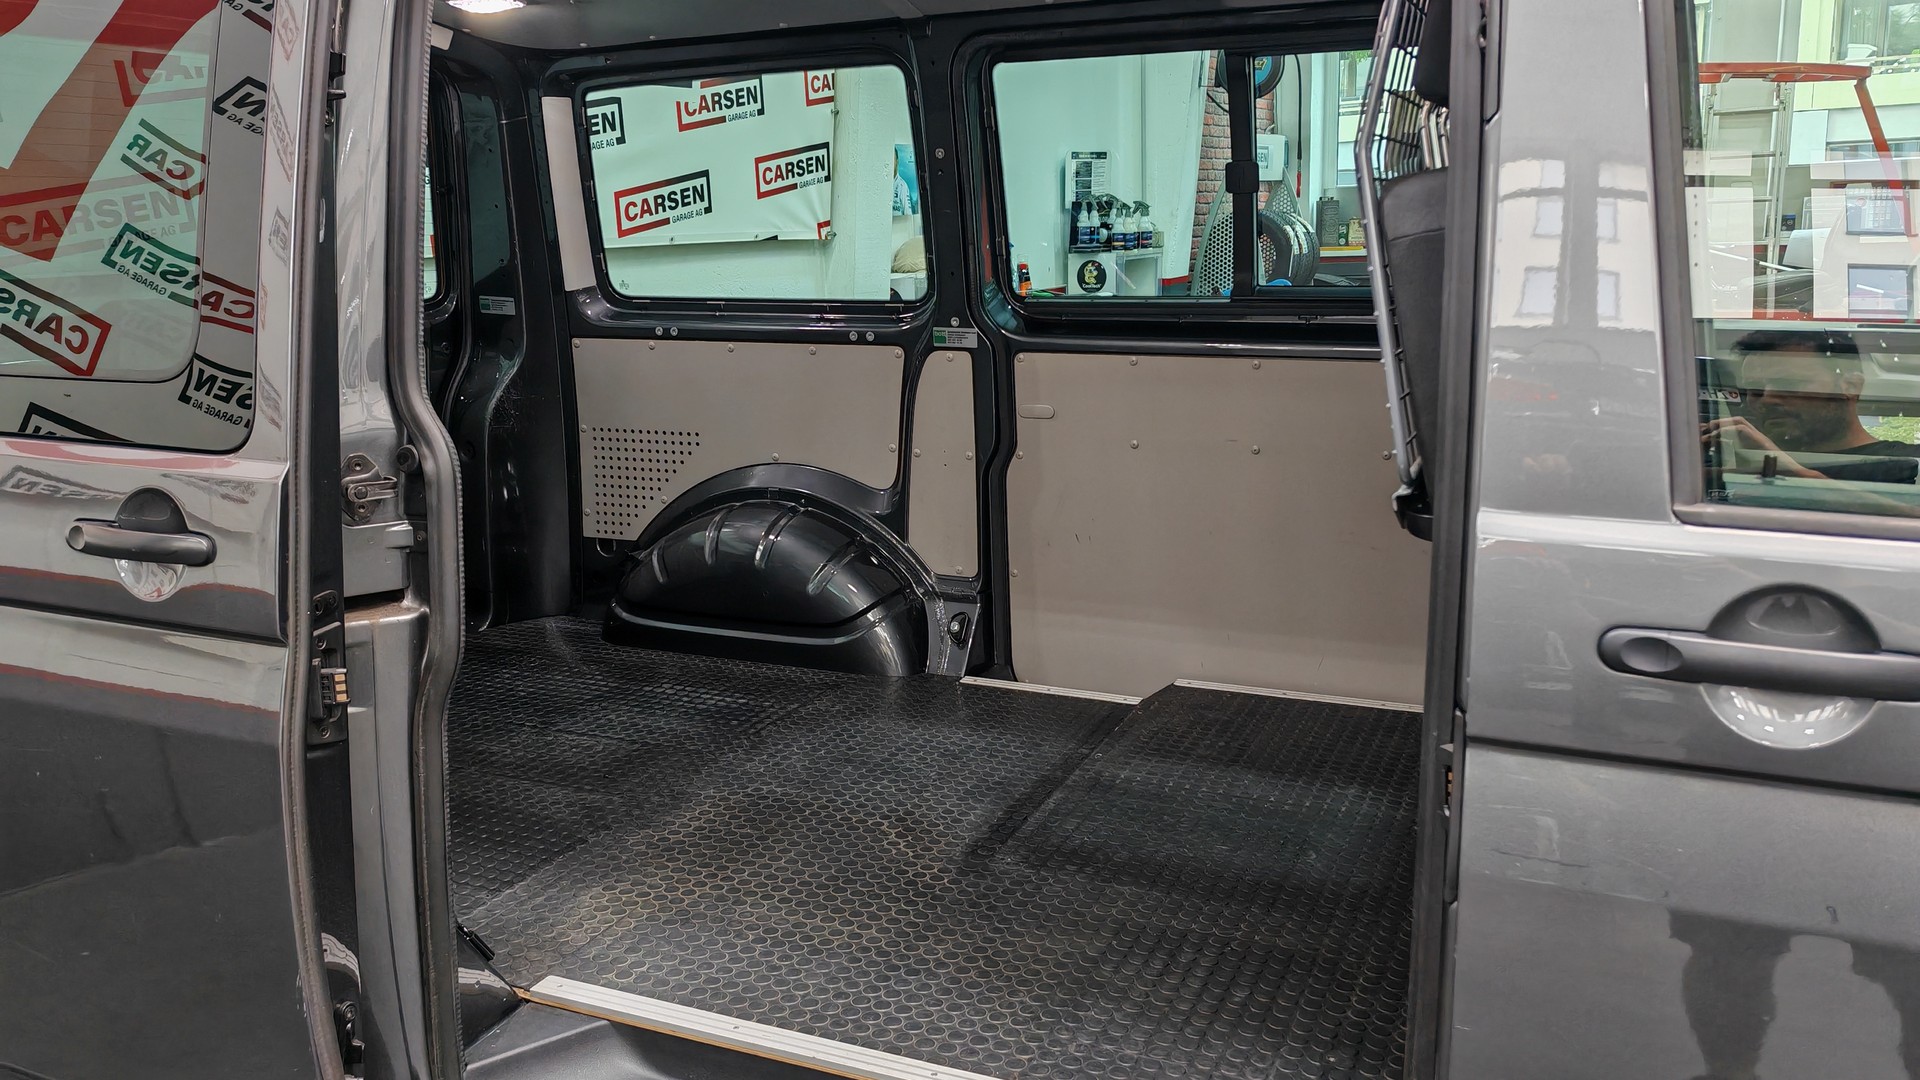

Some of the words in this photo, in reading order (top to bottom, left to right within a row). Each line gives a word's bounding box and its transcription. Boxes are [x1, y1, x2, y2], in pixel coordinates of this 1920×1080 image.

[727, 112, 748, 123] GARAGE
[749, 109, 757, 118] AG
[606, 138, 615, 148] AG
[762, 154, 826, 186] CARSEN
[816, 176, 824, 184] AG
[624, 184, 705, 223] CARSEN
[671, 211, 694, 224] GARAGE
[694, 208, 703, 218] AG
